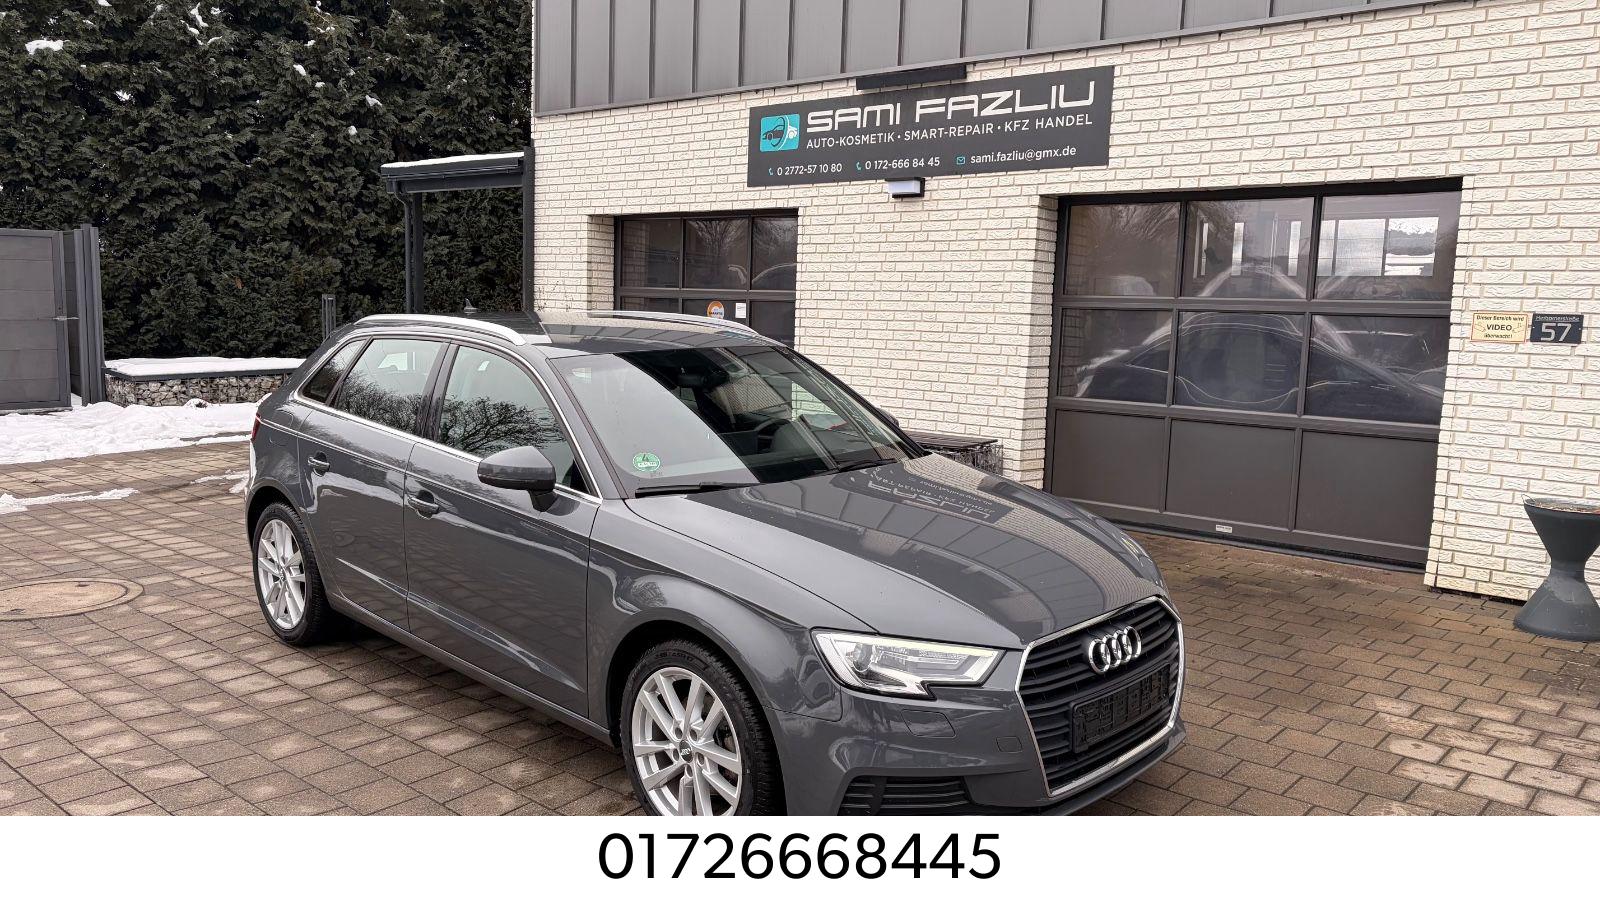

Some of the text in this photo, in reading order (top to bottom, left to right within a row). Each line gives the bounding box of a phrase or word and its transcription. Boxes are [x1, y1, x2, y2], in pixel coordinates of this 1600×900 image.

[806, 80, 1096, 133] SAMI FAZLIU
[806, 113, 1094, 150] AUTO-KOSMETIK SMART-REPAIR KFZ HANDEL
[865, 156, 941, 170] 0 172-666 84 45
[970, 145, 1077, 165] sami.fazliu@gmx.de
[777, 163, 843, 176] 0 2772-57 10 80
[1486, 323, 1513, 332] VIDEO
[1540, 322, 1572, 342] 57
